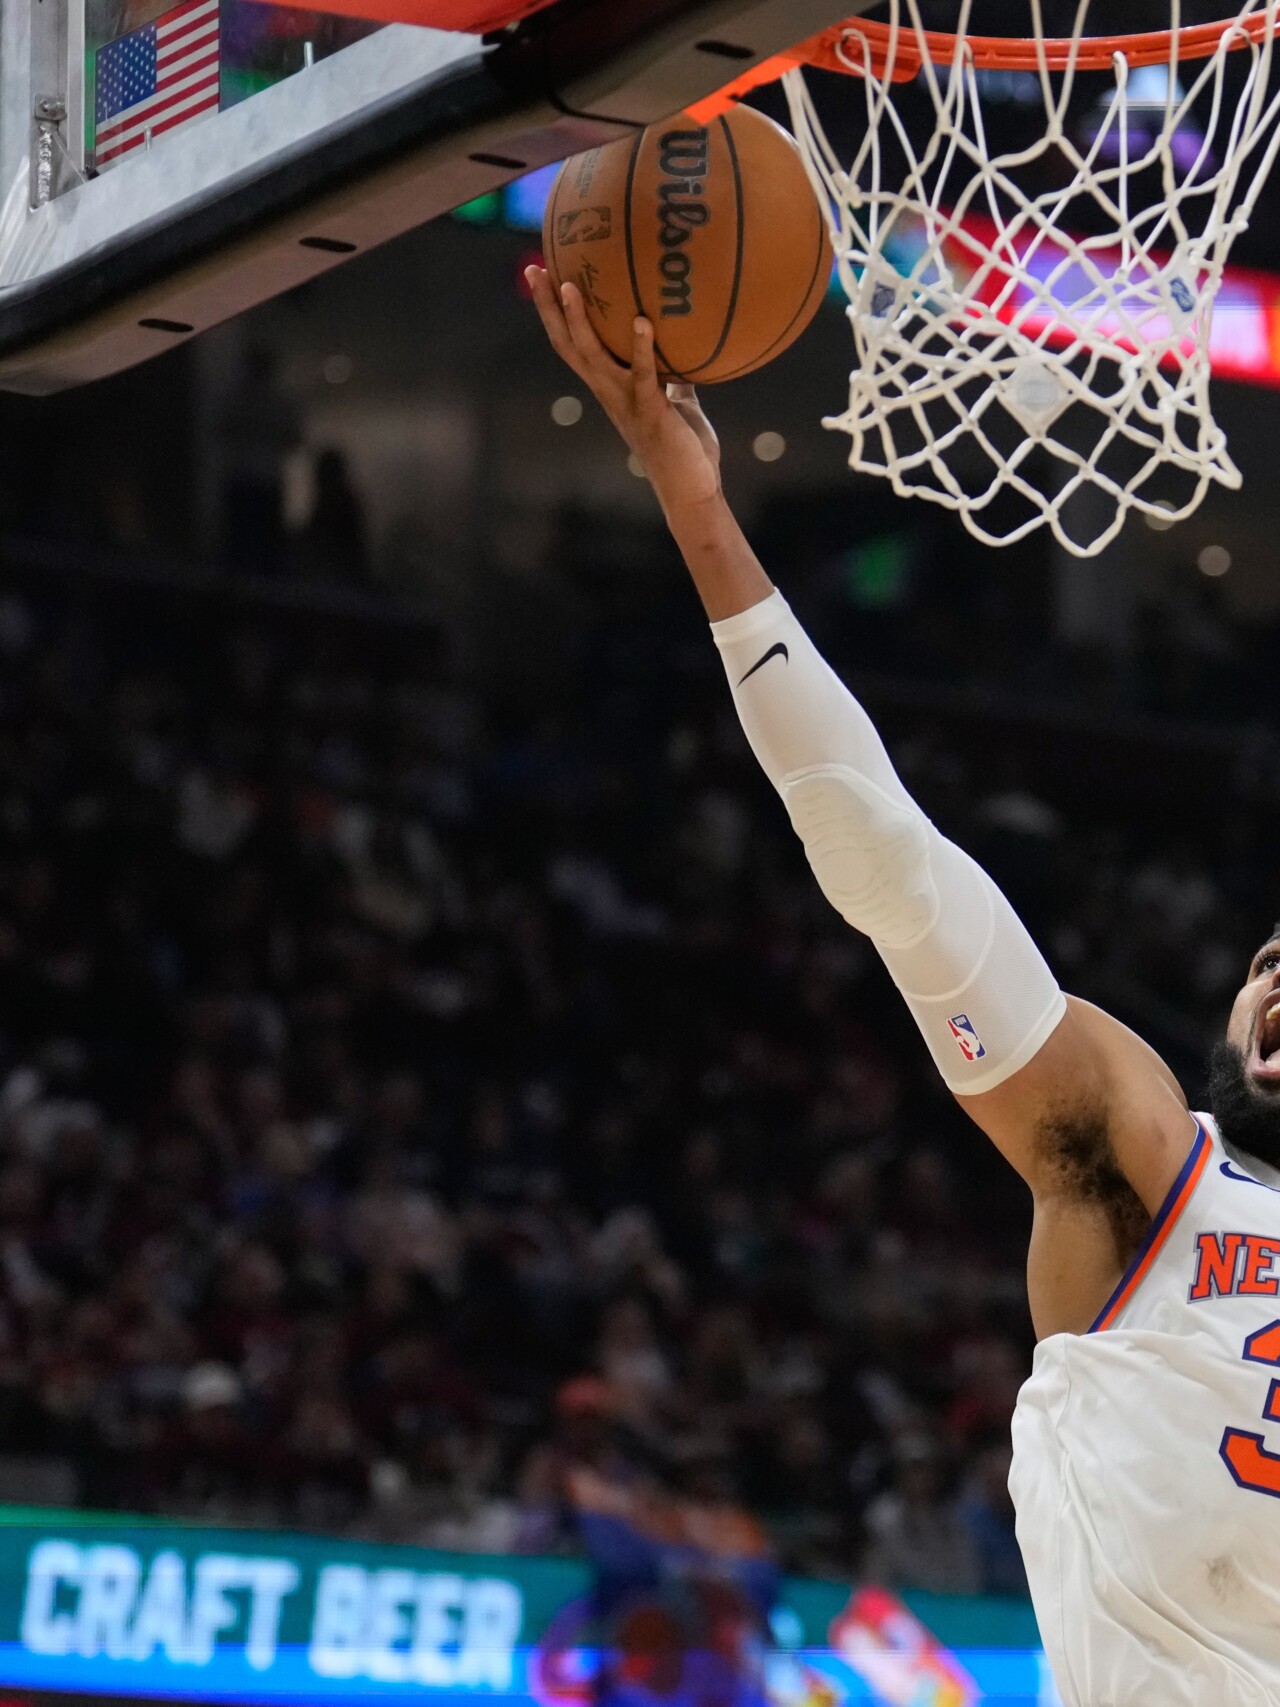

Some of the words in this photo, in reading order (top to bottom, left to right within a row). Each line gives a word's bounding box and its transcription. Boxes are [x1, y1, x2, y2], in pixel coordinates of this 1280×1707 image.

[658, 128, 709, 317] Wilson
[21, 1538, 299, 1671] CRAFT
[308, 1563, 522, 1689] BEER
